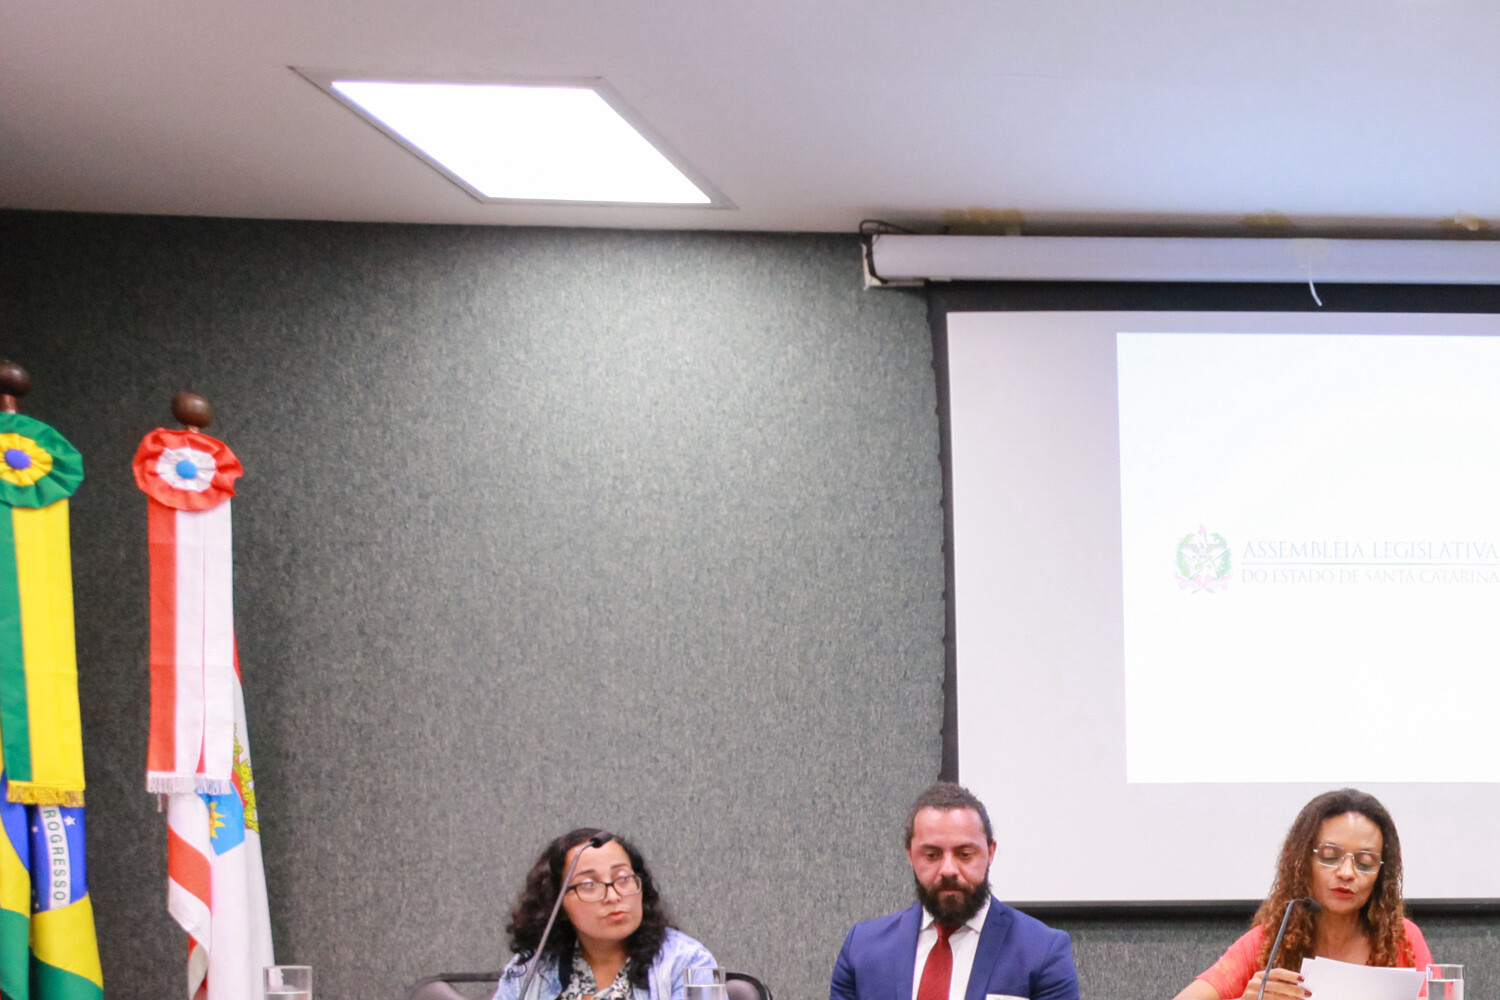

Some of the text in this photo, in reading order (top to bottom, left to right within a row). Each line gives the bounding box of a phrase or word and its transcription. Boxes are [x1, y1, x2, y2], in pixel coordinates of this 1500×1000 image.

[1242, 541, 1499, 559] ASSEMBLEIA LEGISLATIVA
[1242, 569, 1500, 584] DO ESTADO DE SANTA CATARINA
[44, 809, 67, 901] ROGRESSO
